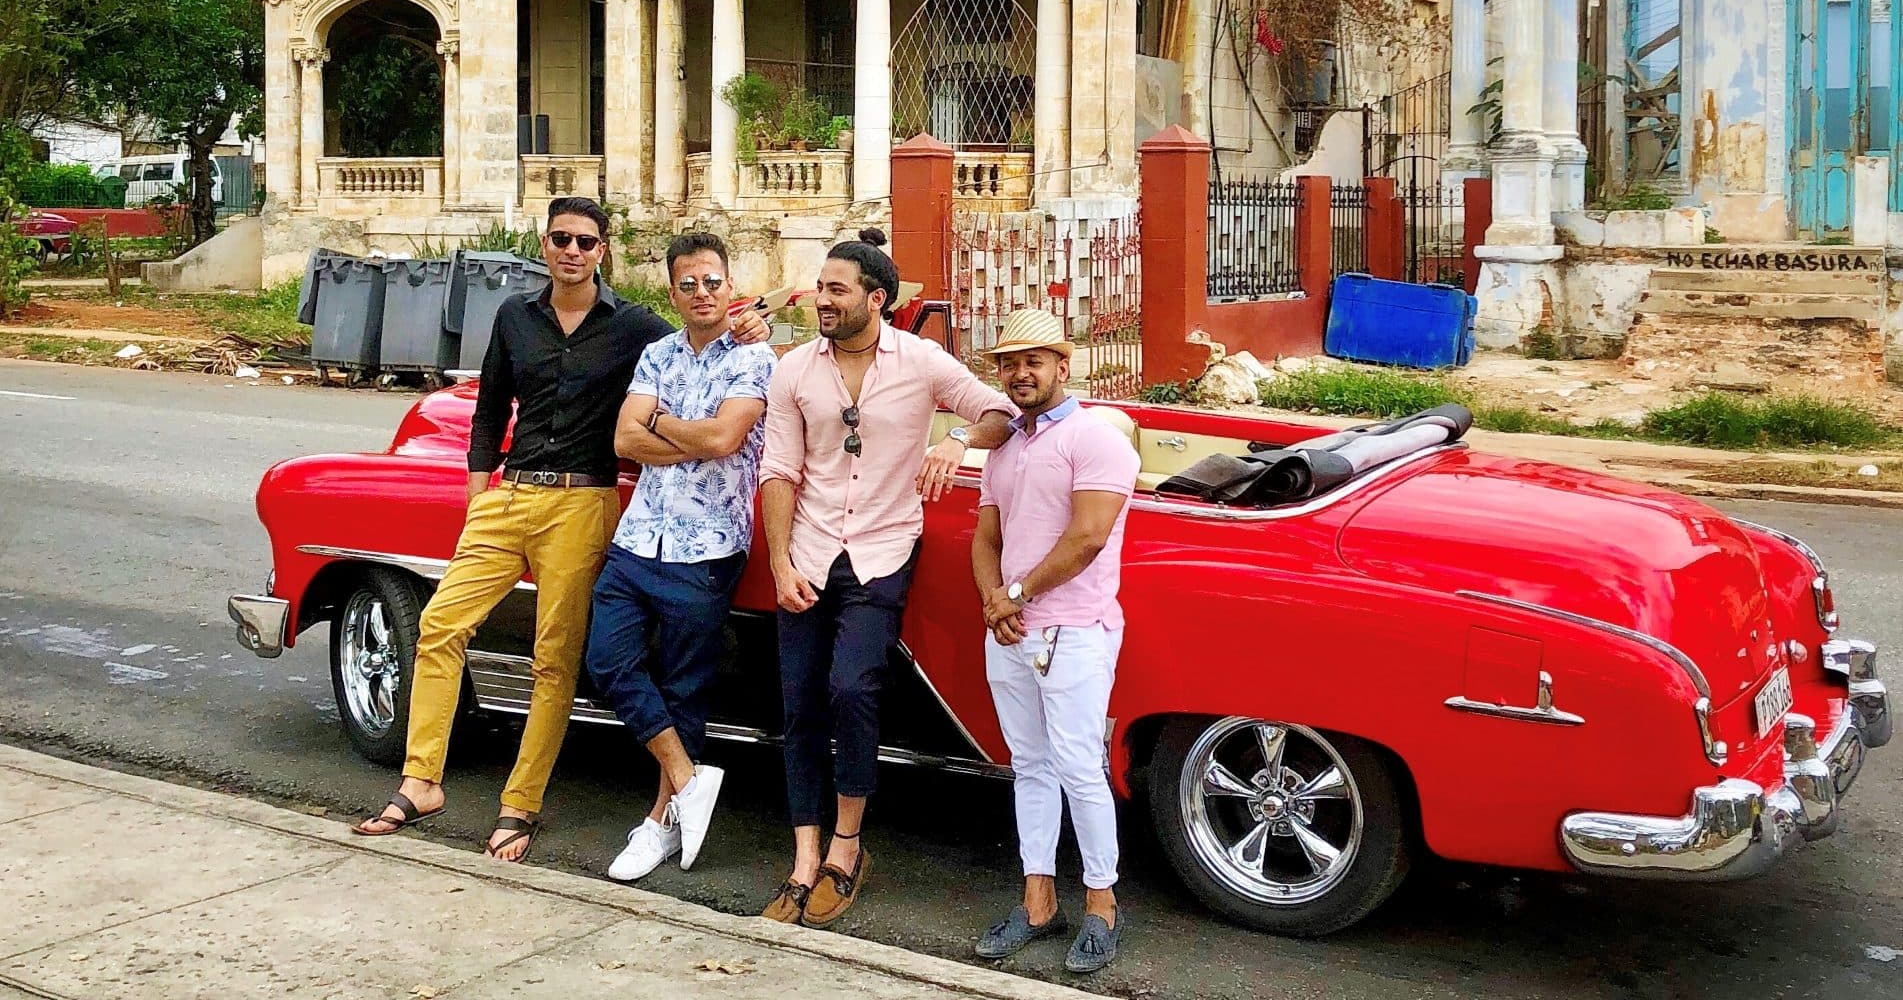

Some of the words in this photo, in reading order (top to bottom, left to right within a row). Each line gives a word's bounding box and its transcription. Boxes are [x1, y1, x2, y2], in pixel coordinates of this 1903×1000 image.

[1667, 251, 1693, 267] NO
[1701, 252, 1768, 270] ECHAR
[1774, 253, 1868, 271] BASURA
